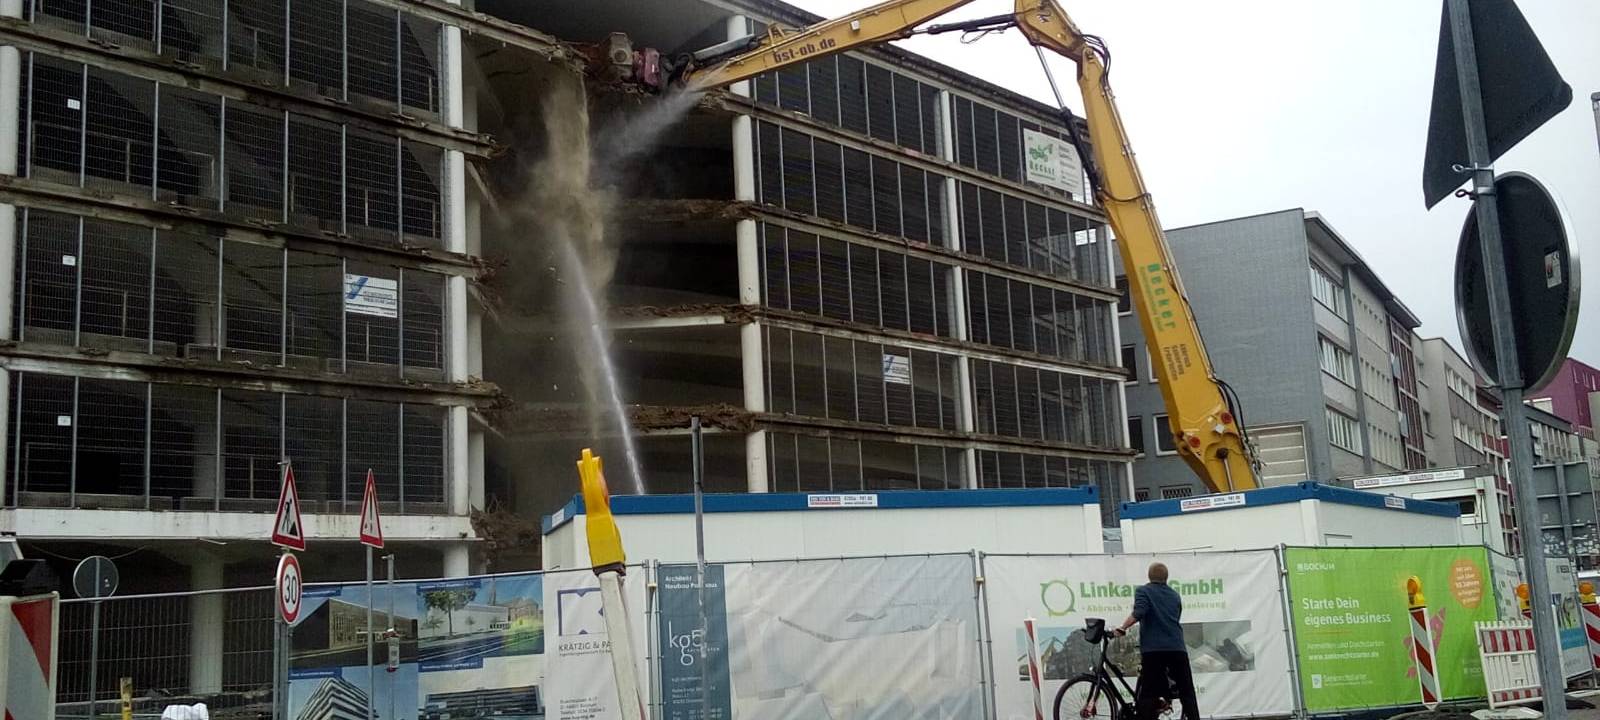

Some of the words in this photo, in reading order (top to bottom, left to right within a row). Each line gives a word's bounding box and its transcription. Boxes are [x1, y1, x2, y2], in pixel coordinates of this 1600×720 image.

[773, 38, 836, 63] bst-ob.de
[1147, 263, 1176, 329] Becker
[284, 575, 297, 605] 30
[1080, 581, 1138, 598] Linka
[1168, 578, 1224, 596] GmbH
[1302, 597, 1335, 610] Starte
[1336, 596, 1360, 609] Dein
[1304, 613, 1345, 628] eigenes
[1345, 611, 1392, 625] Business
